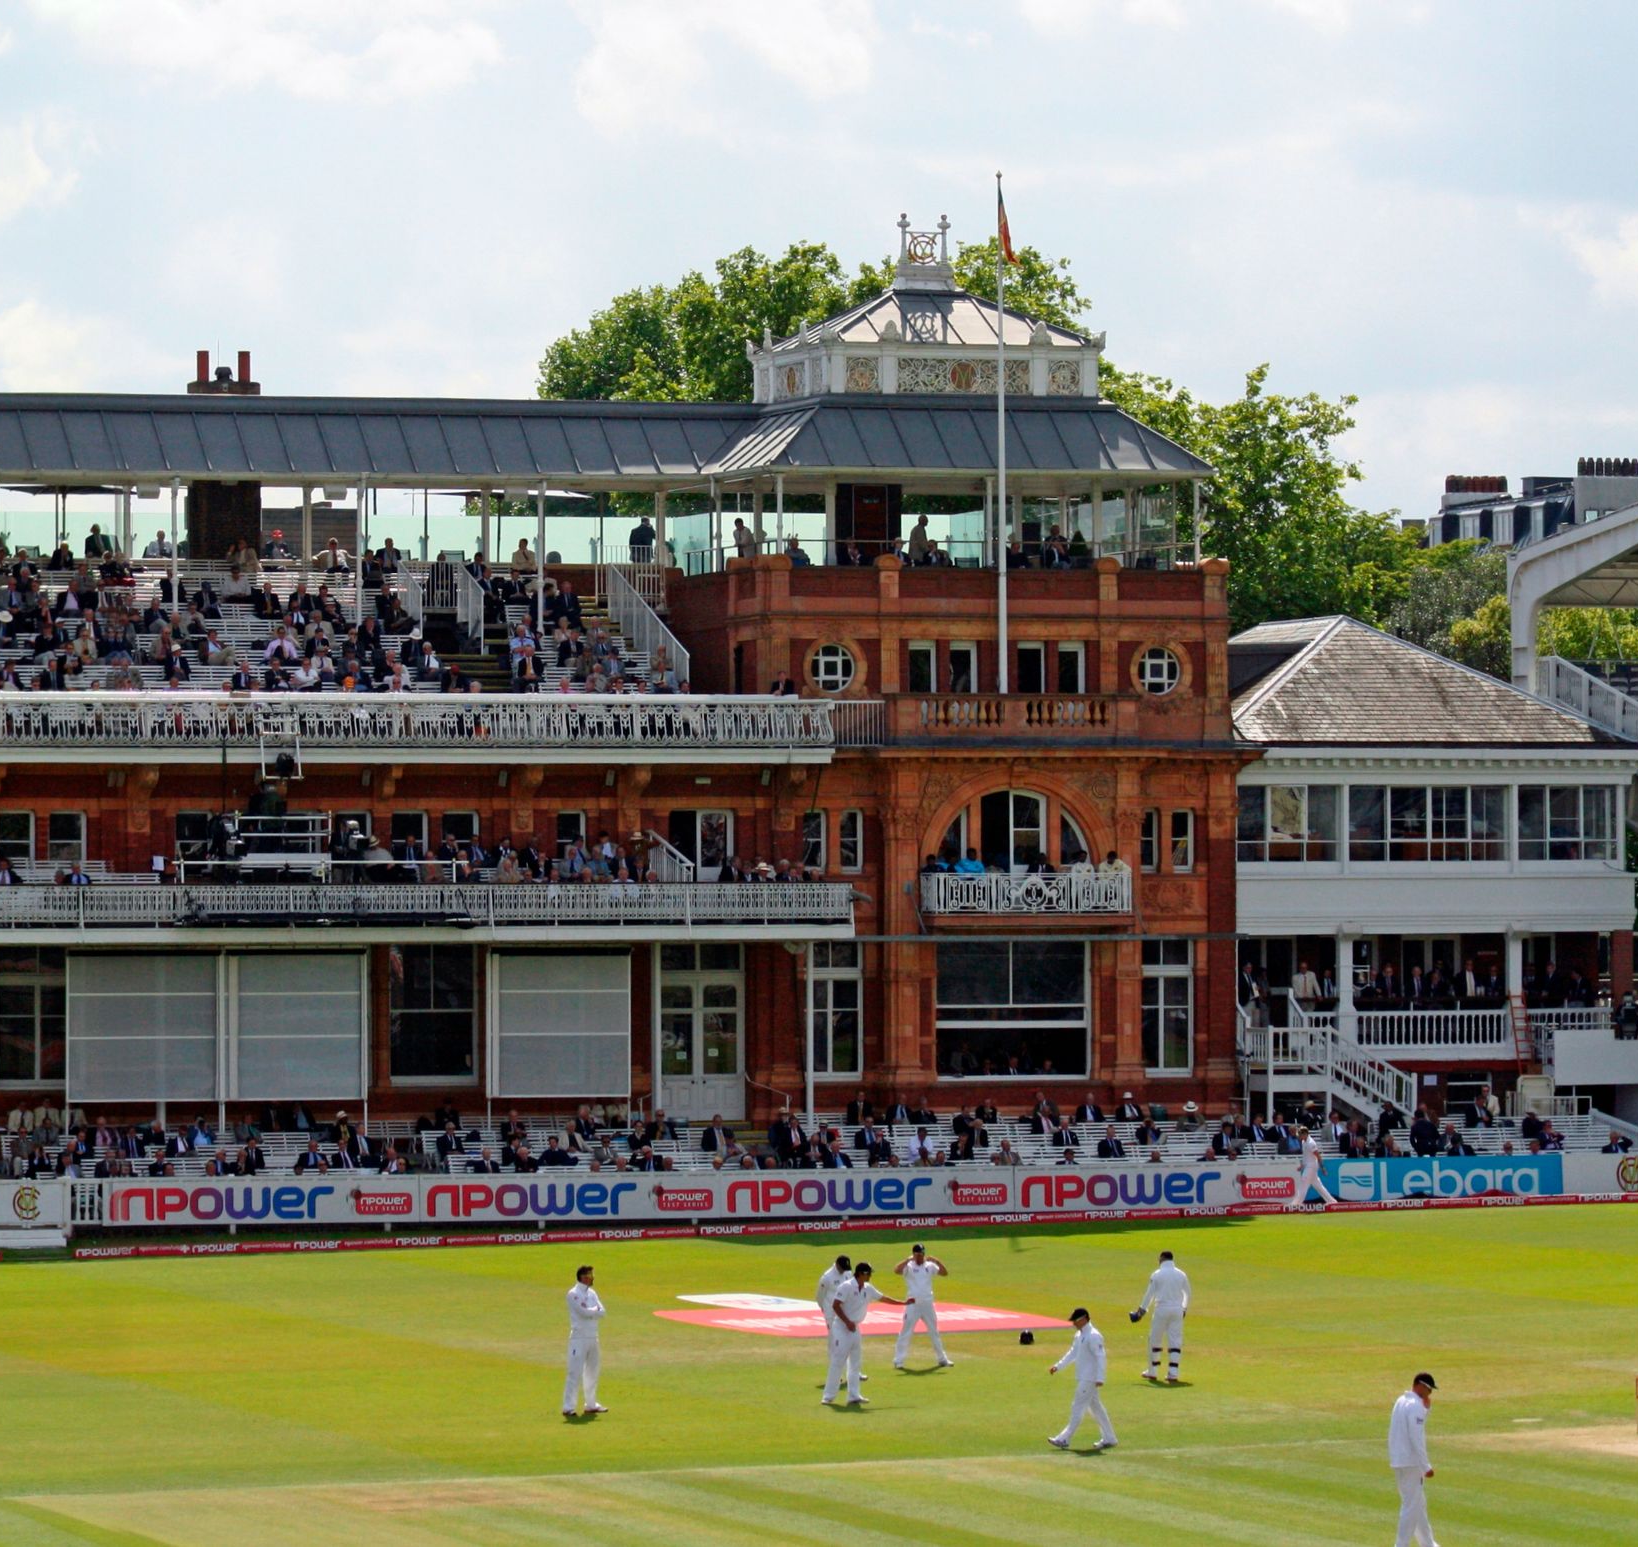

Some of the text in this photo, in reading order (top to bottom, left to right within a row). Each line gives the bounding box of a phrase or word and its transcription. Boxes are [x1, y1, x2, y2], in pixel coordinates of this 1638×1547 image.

[1022, 1172, 1220, 1208] npower
[1246, 1181, 1290, 1189] npower
[1378, 1161, 1541, 1197] Lebara
[361, 1197, 409, 1205] npower
[427, 1183, 637, 1217] npower
[662, 1193, 708, 1202] npower
[727, 1178, 932, 1213] npower
[957, 1187, 1002, 1195] npower
[110, 1186, 334, 1221] npower
[799, 1221, 844, 1231] npower
